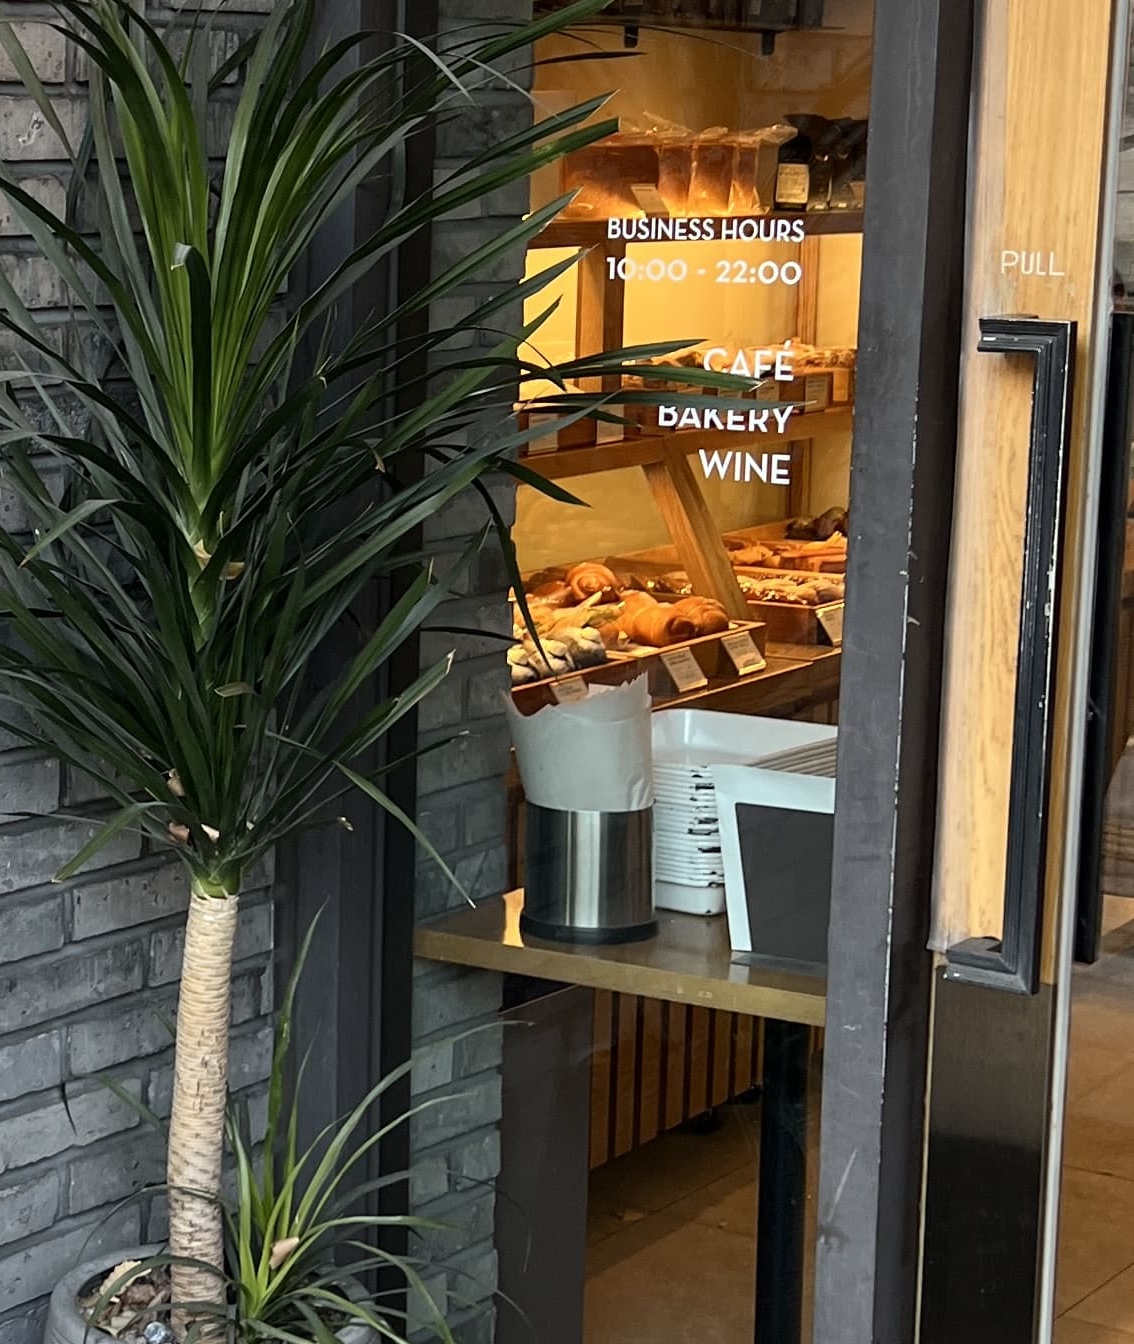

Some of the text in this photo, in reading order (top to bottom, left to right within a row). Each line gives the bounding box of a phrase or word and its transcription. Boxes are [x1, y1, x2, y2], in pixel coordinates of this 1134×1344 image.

[607, 217, 805, 243] BUSINESS HOURS
[606, 256, 688, 282] 10:00
[715, 260, 802, 285] 22:00
[1001, 250, 1066, 276] PULL
[703, 339, 795, 382] CAFÉ
[658, 404, 794, 434] BAKERY
[698, 448, 792, 485] WINE
